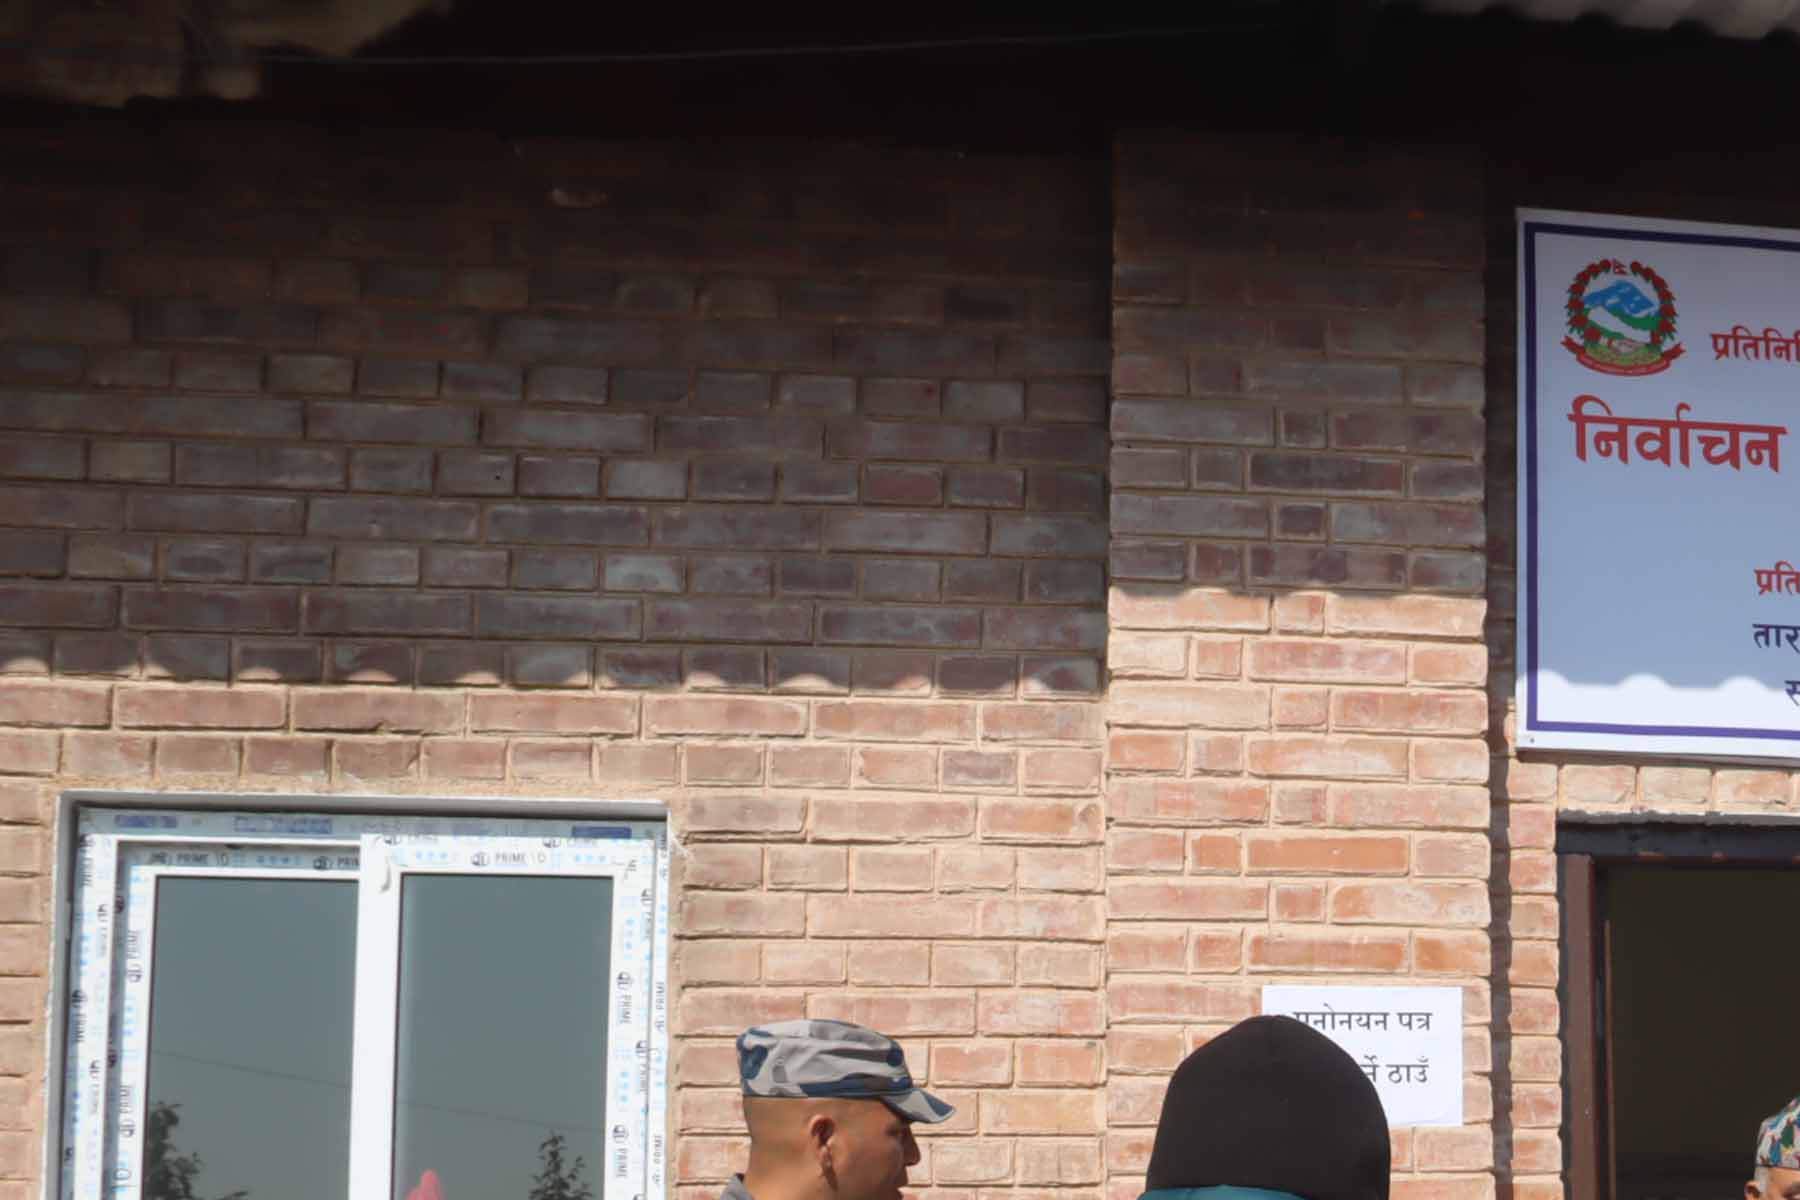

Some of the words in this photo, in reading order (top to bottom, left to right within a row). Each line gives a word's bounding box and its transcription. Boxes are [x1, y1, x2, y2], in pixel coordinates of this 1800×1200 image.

[1568, 394, 1786, 471] निर्वाचन
[1397, 1012, 1432, 1031] पत्र
[1386, 1056, 1429, 1083] ठाउँ
